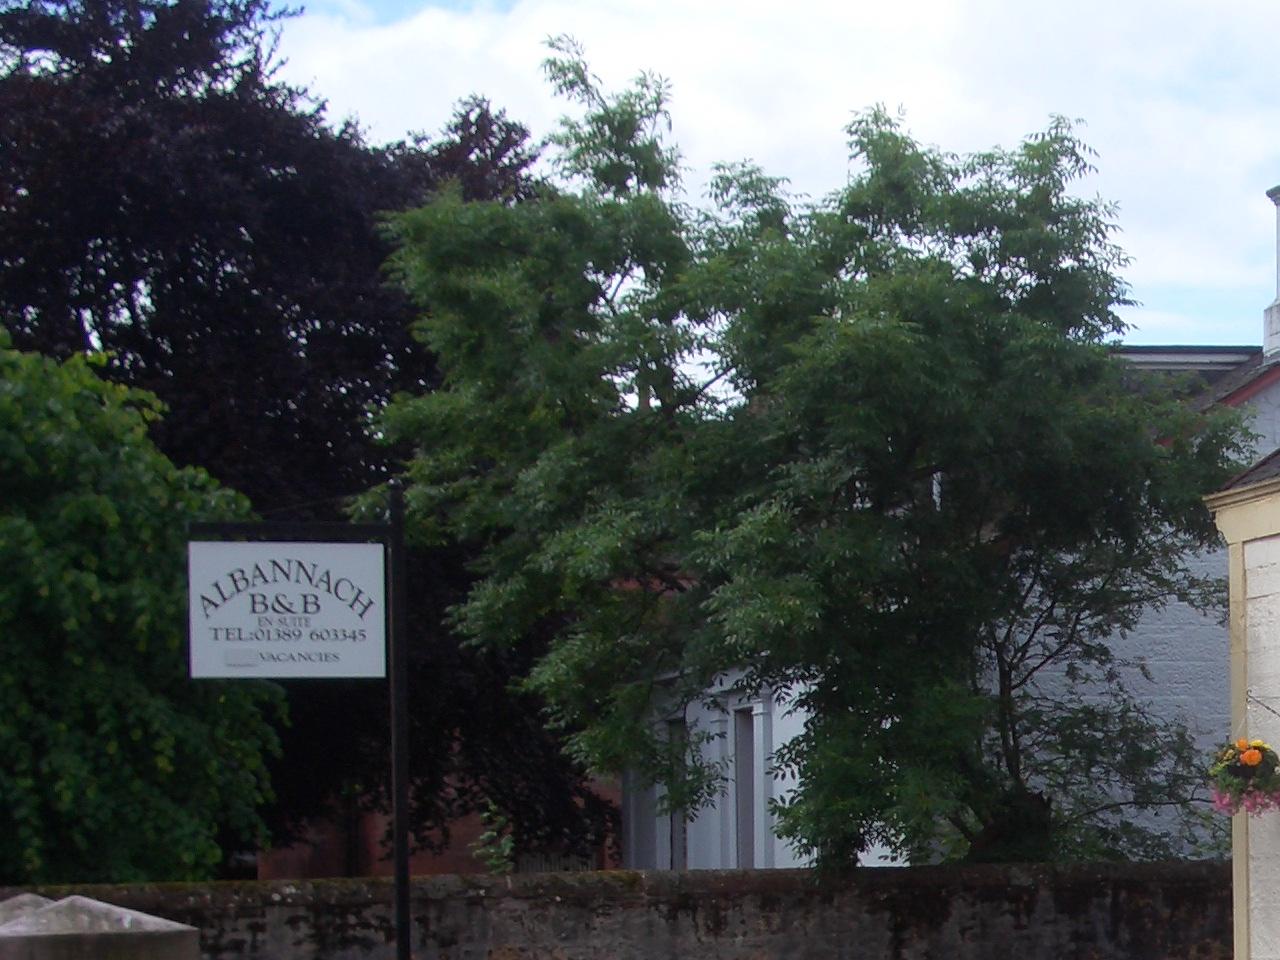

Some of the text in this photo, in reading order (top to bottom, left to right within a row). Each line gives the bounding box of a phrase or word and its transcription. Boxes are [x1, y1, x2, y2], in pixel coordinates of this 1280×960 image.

[200, 559, 375, 619] ALBANNACH
[250, 593, 321, 614] B&B
[310, 628, 367, 642] 603345
[259, 651, 340, 663] VACANCIES
